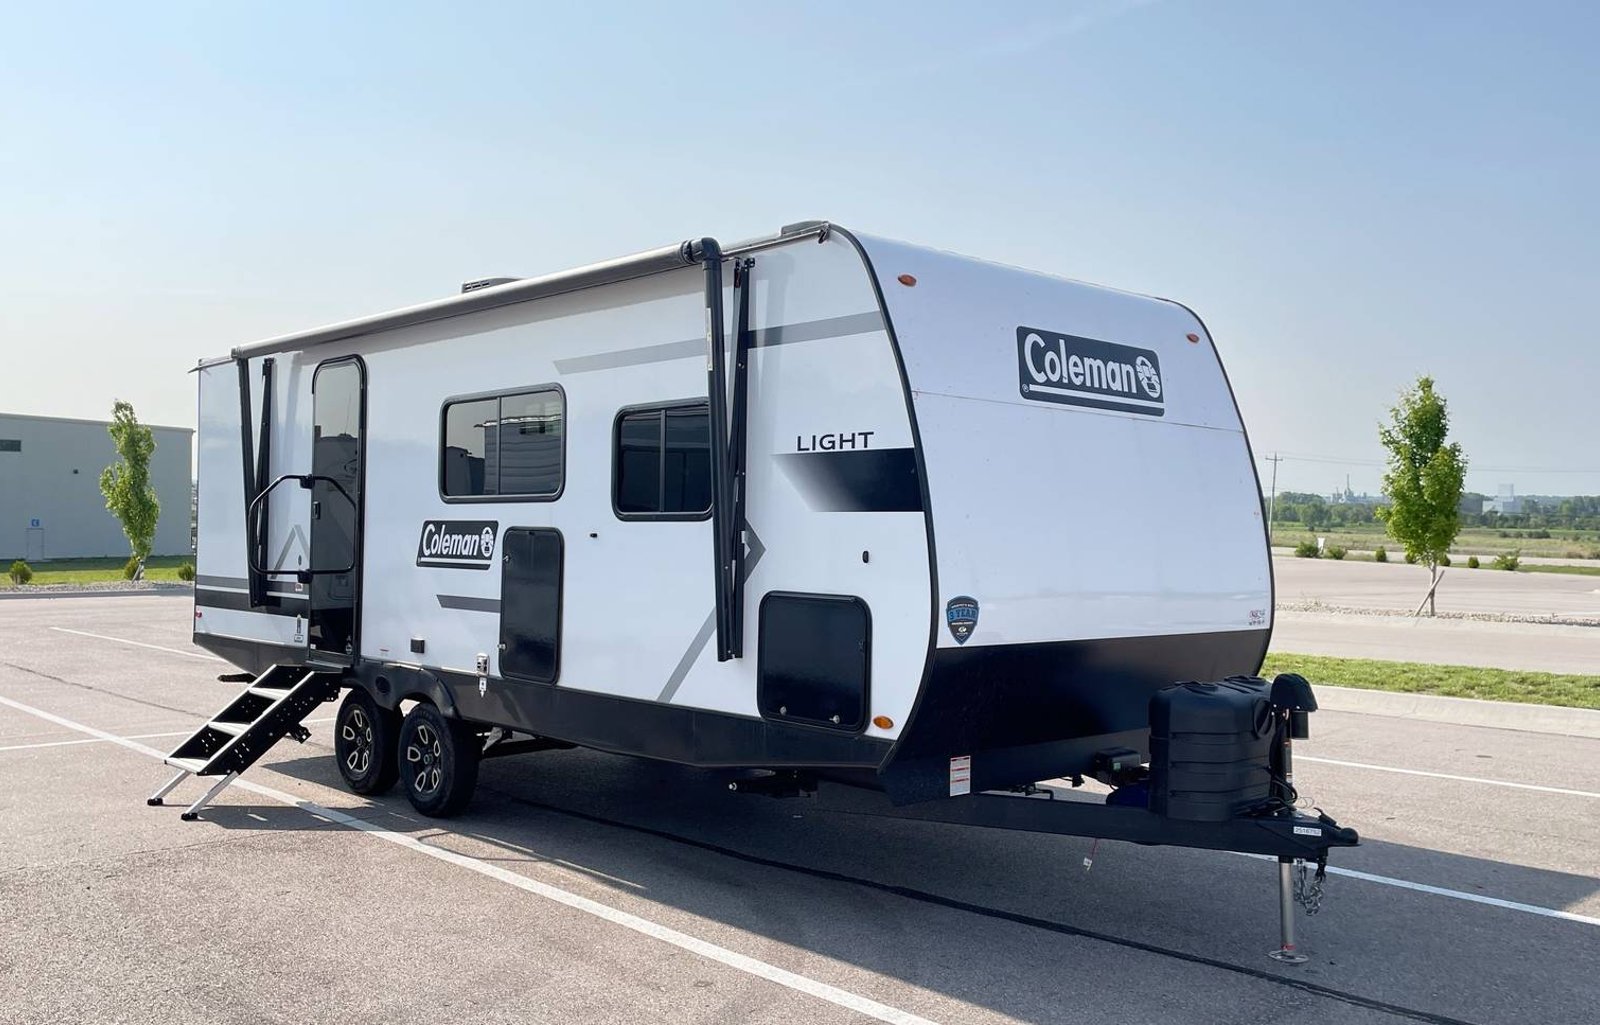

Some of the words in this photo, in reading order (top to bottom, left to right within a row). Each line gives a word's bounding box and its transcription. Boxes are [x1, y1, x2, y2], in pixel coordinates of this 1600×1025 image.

[1024, 333, 1137, 393] Coleman
[797, 431, 874, 451] LIGHT
[422, 523, 480, 556] Coleman
[956, 608, 976, 619] YEAR
